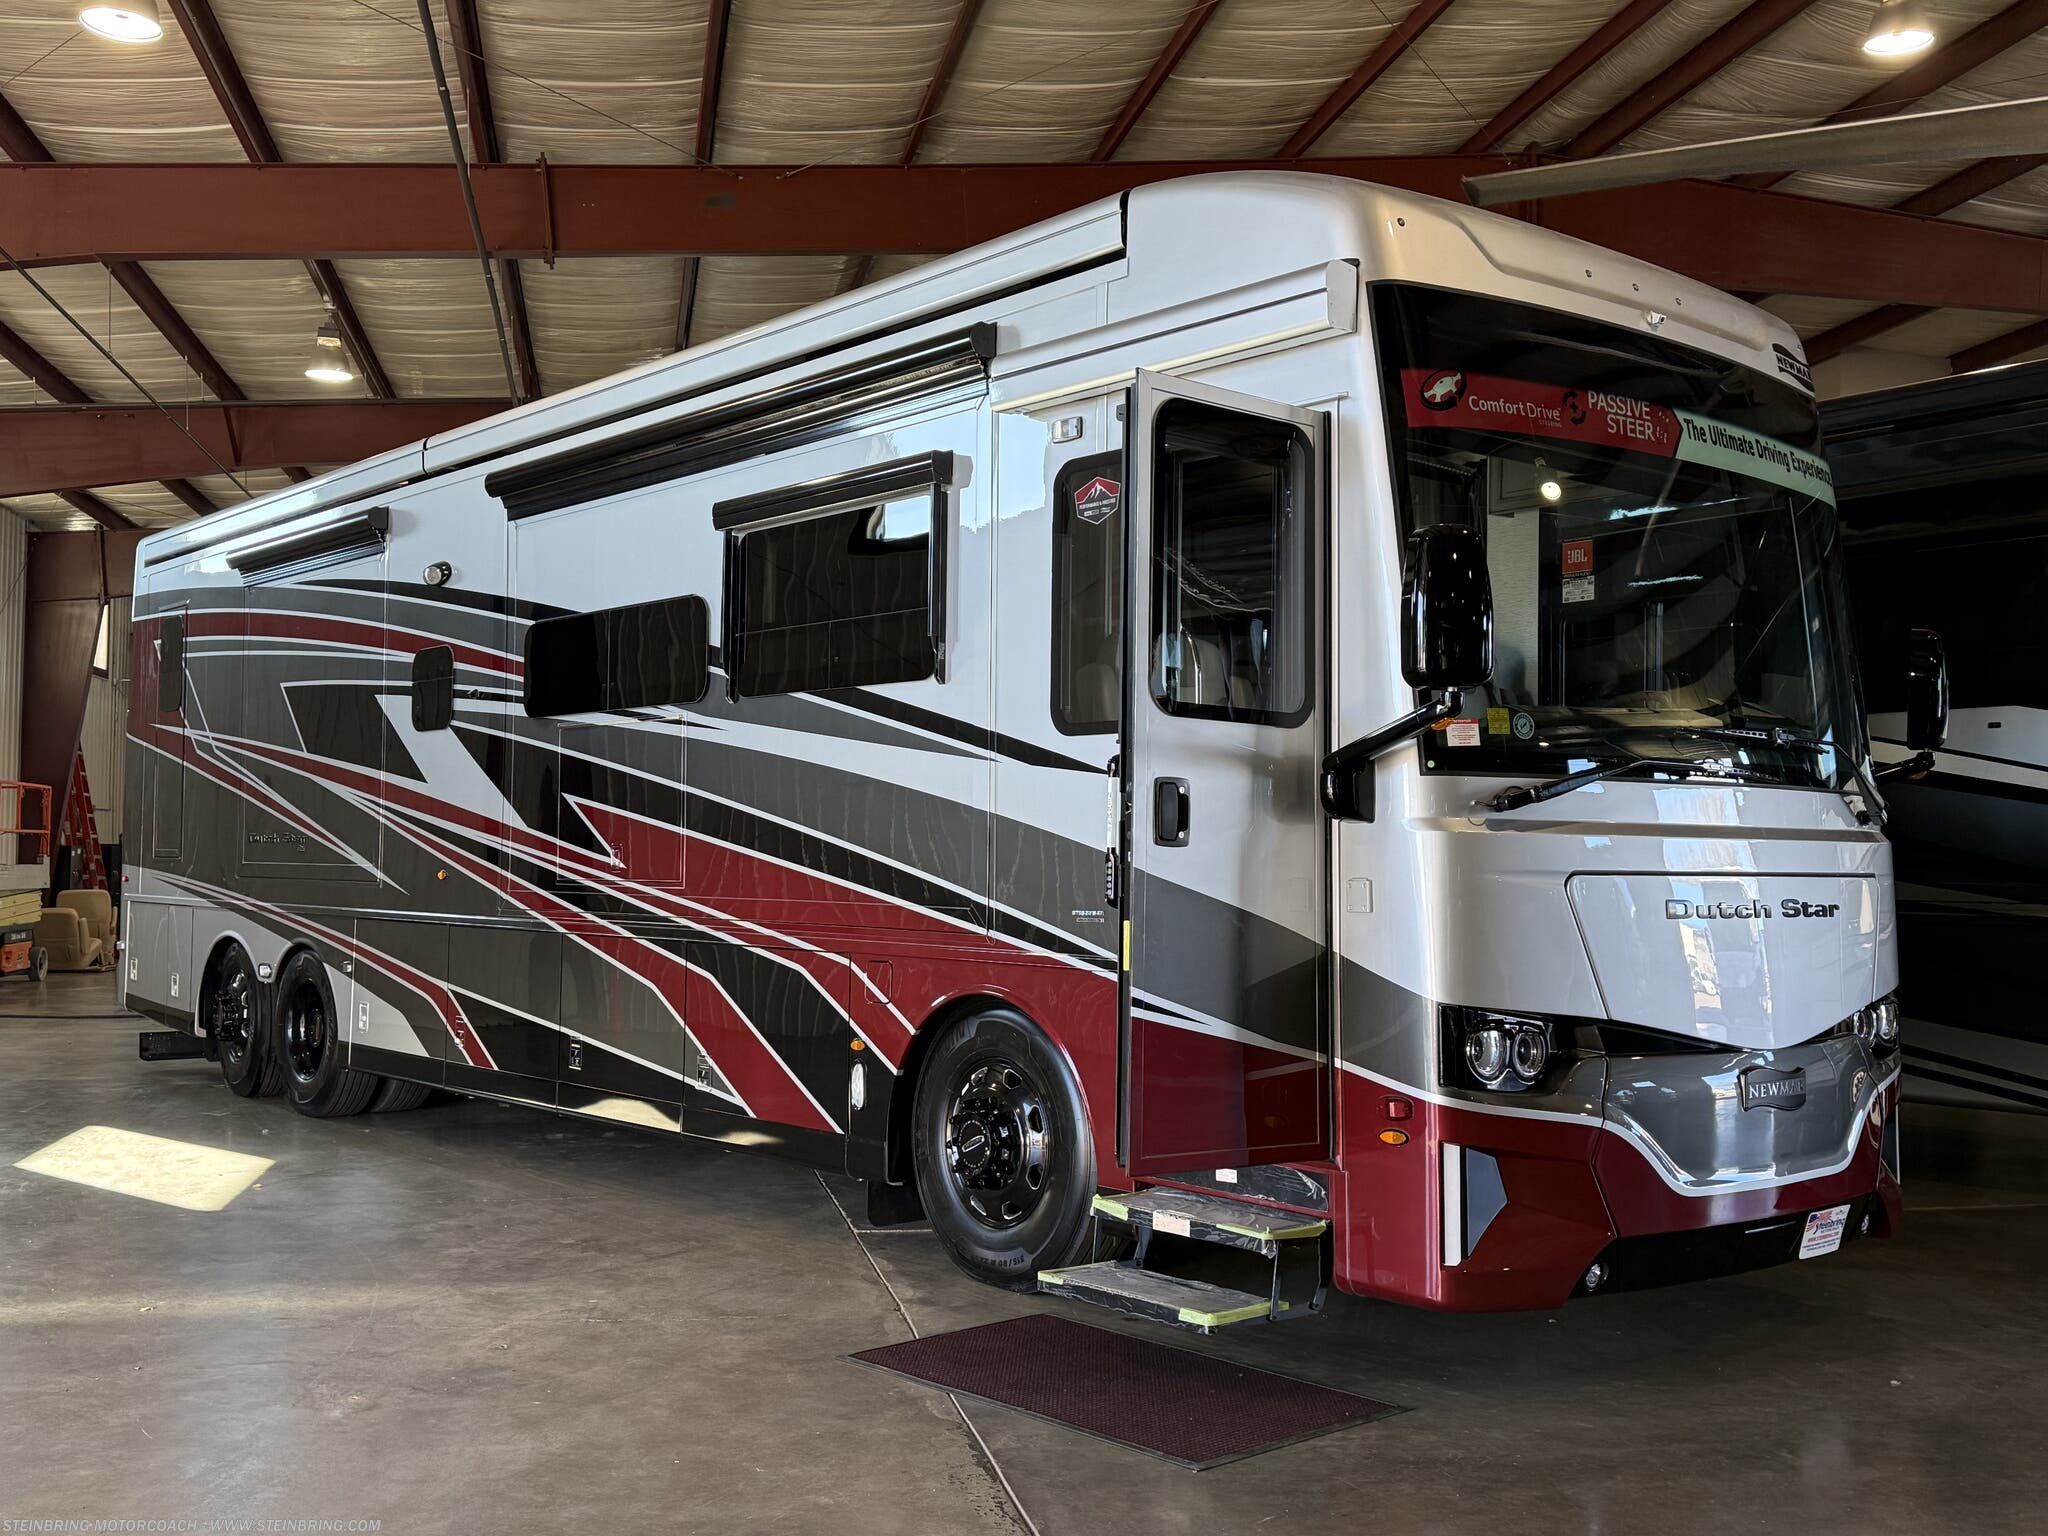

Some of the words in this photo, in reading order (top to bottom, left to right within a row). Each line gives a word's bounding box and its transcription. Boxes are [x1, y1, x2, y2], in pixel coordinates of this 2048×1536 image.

[1468, 395, 1526, 416] Comfort
[1527, 402, 1561, 421] Drive
[1588, 390, 1651, 419] PASSIVE
[1607, 414, 1655, 442] STEER
[1683, 418, 1707, 443] The
[1708, 424, 1756, 457] Ultimate
[1755, 438, 1791, 472] Driving
[1567, 548, 1588, 564] JBL
[1665, 898, 1772, 920] Dutch
[1781, 898, 1840, 919] Star
